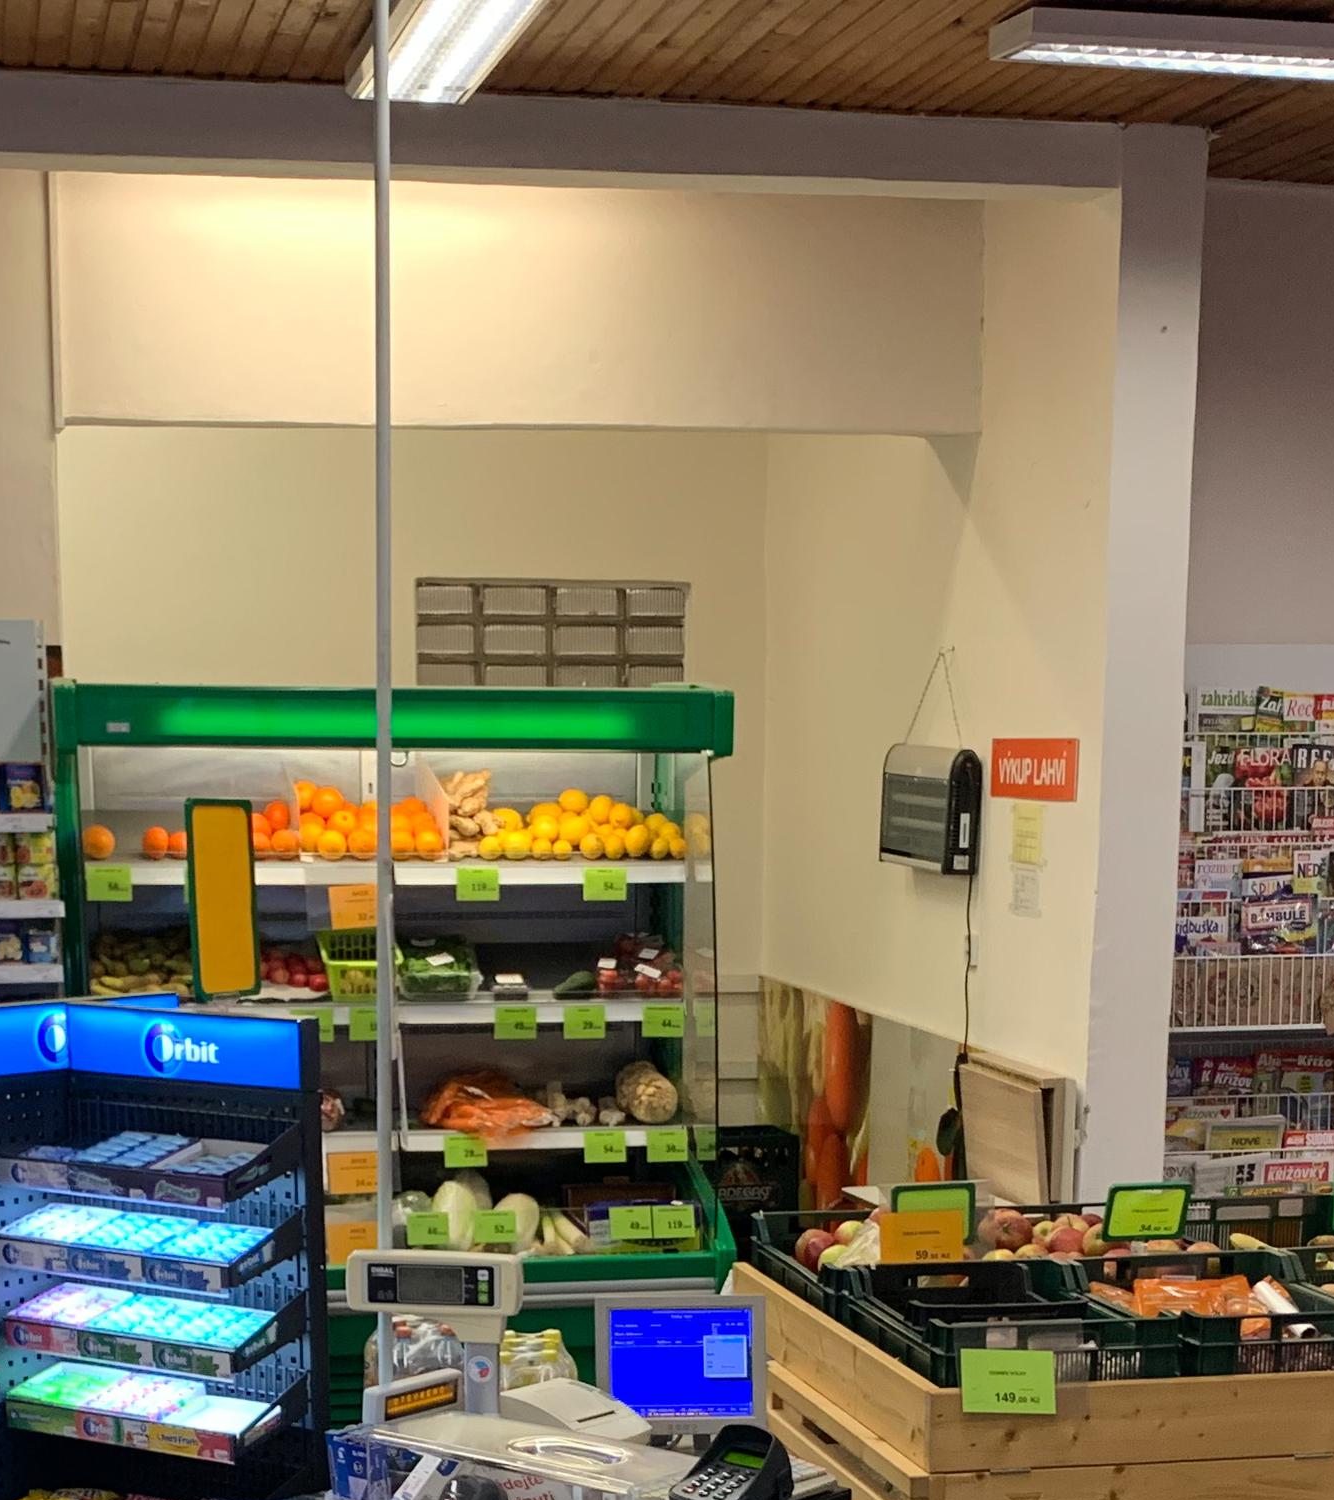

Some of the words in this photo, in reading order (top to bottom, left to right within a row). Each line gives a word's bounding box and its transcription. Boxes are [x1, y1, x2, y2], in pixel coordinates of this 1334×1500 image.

[999, 751, 1032, 785] VÝKUP
[1033, 751, 1067, 786] LAHVÍ
[1239, 749, 1292, 768] FLORA
[147, 1022, 219, 1074] Orbit
